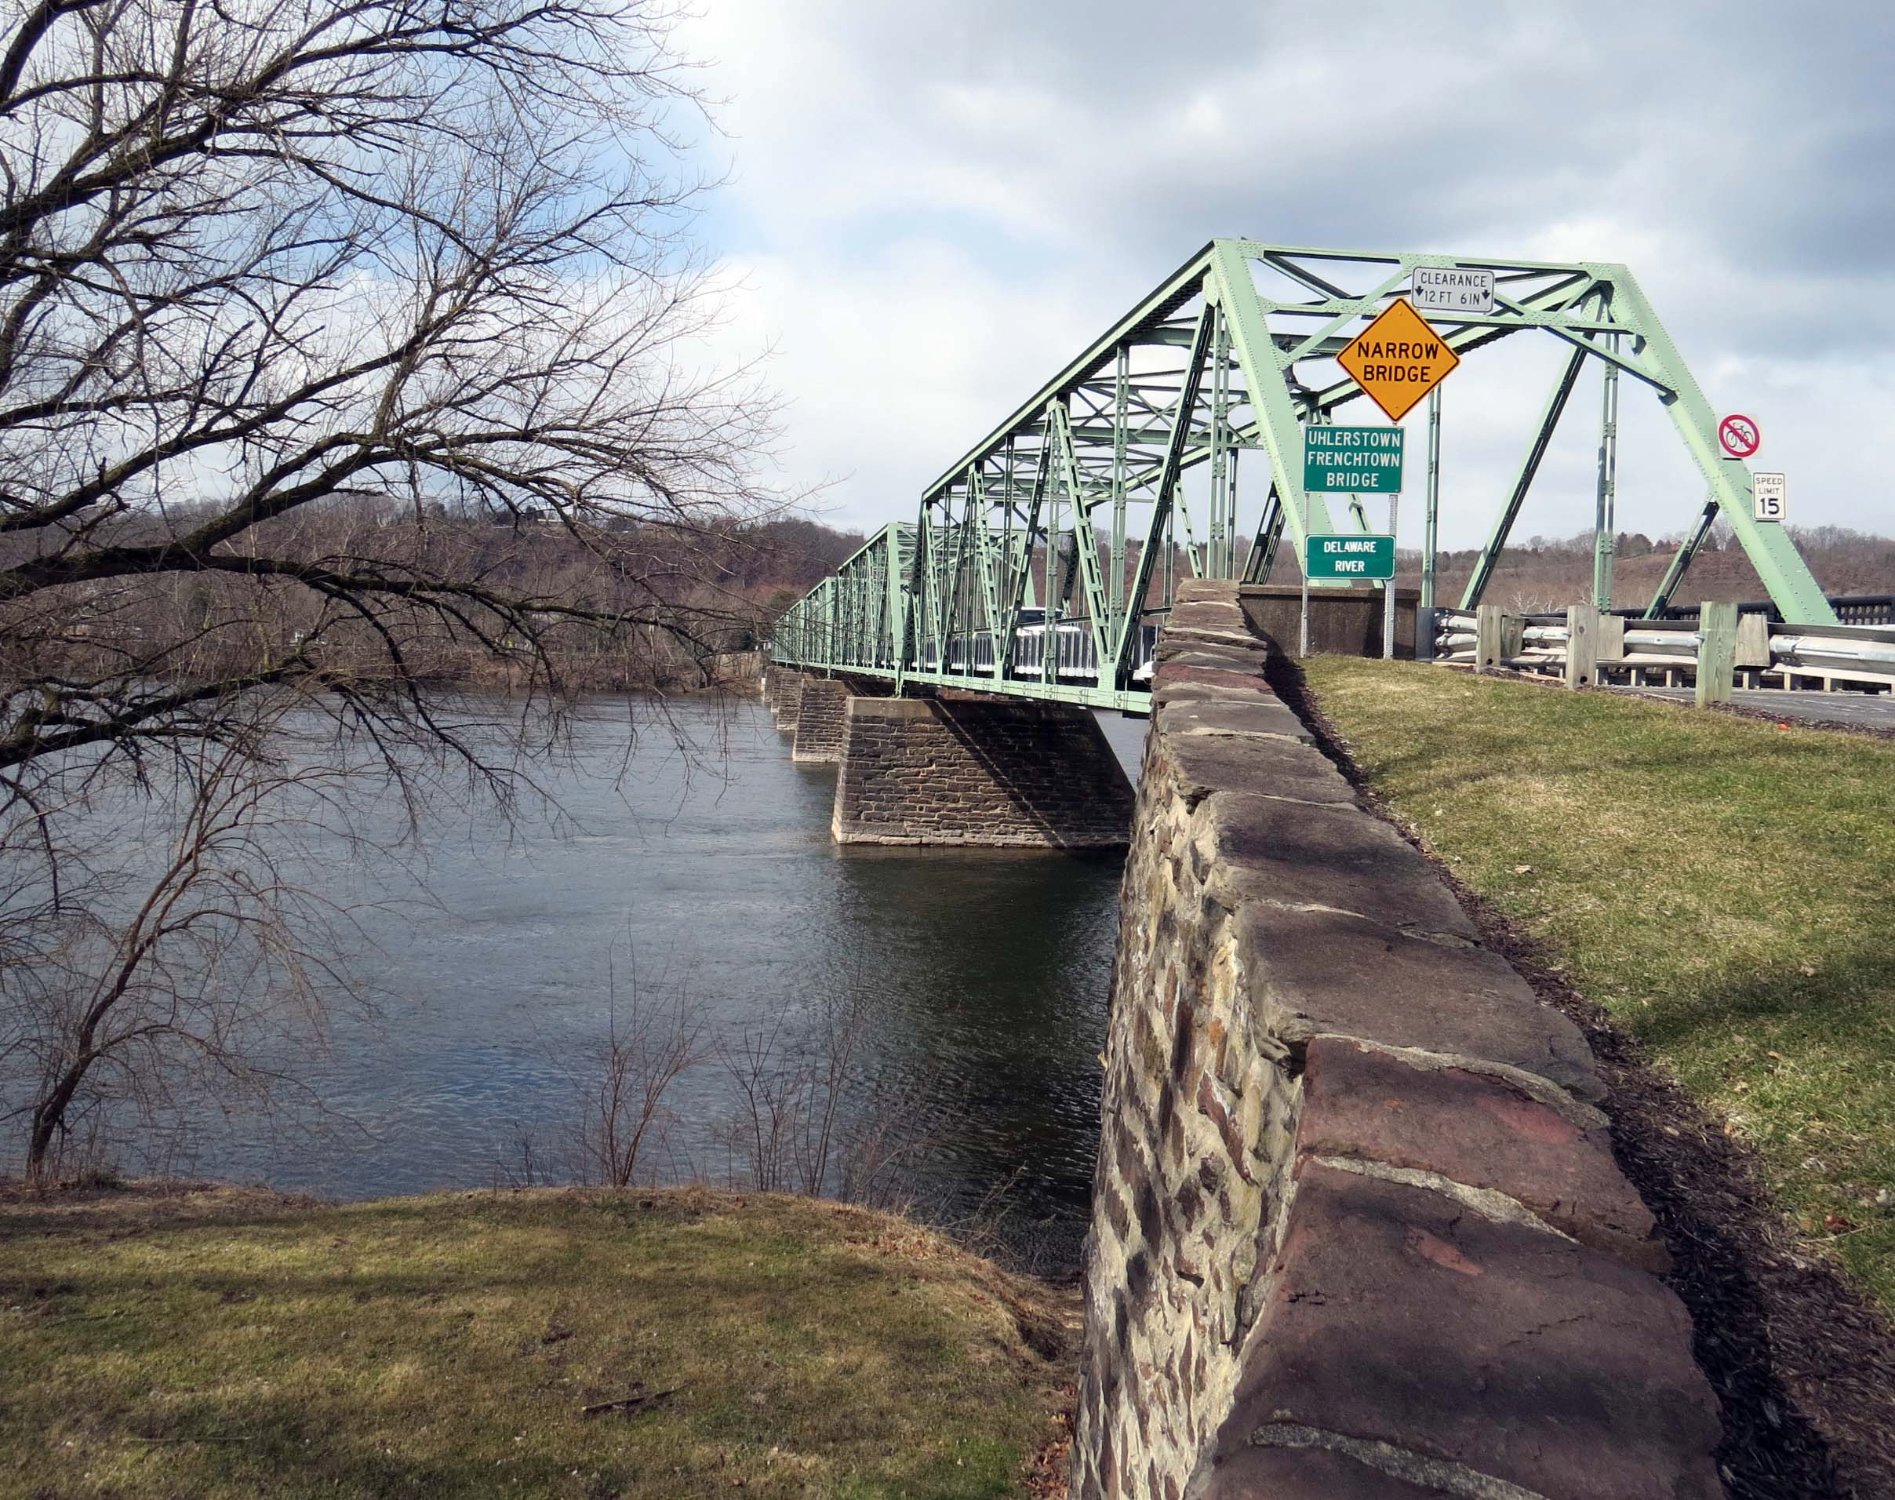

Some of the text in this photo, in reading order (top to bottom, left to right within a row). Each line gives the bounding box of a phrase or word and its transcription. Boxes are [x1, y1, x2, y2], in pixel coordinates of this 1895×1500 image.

[1420, 272, 1487, 287] CLEARANCE
[1357, 341, 1440, 360] NARROW
[1363, 365, 1431, 383] BRIDGE
[1308, 431, 1401, 448] UHLERSTOWN
[1307, 451, 1400, 467] FRENCHTOWN
[1326, 473, 1379, 487] BRIDGE
[1755, 477, 1783, 485] SPEED
[1760, 498, 1780, 515] 15
[1323, 541, 1377, 553] DELAWARE
[1334, 560, 1365, 573] RIVER
